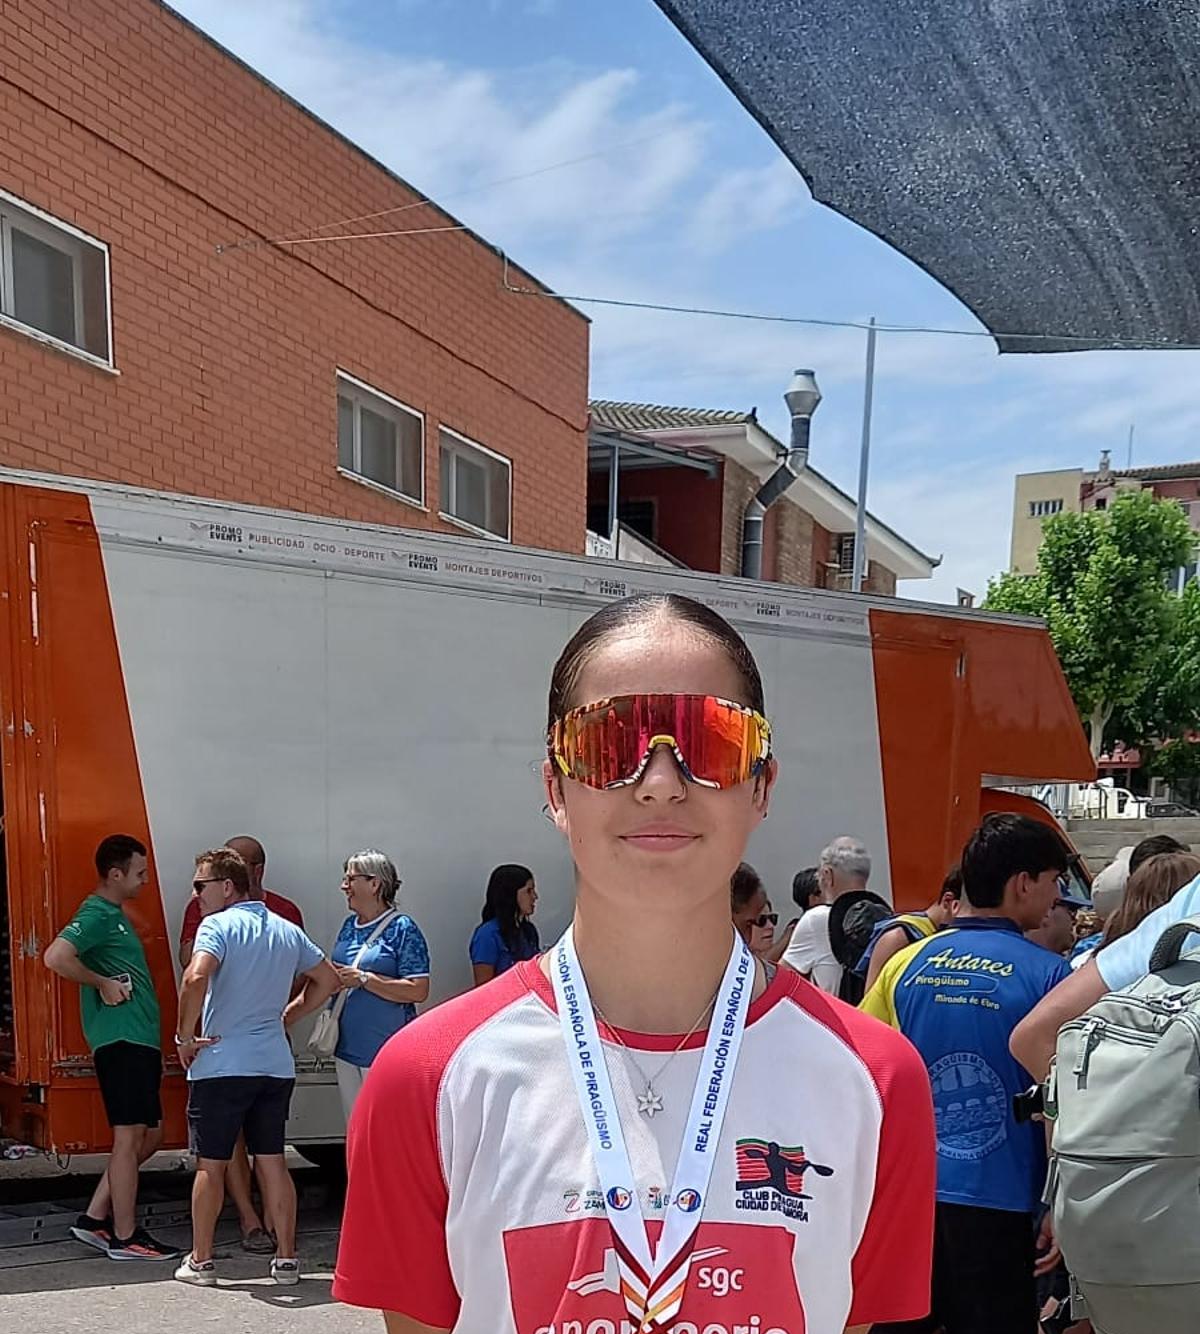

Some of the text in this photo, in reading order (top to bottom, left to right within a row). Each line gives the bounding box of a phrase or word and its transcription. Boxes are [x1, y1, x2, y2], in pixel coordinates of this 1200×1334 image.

[209, 524, 242, 535] PROMO
[209, 532, 242, 543] EVENTS
[249, 533, 304, 549] PUBLICIDAD
[313, 542, 336, 553] OCIO
[344, 548, 385, 561] DEPORTE
[408, 554, 438, 564] PROMO
[408, 561, 438, 571] EVENTS
[445, 562, 542, 583] MONTAJES DEPORTIVOS
[927, 948, 1013, 977] Antares
[935, 994, 1000, 1010] Miranda de Ebro
[563, 984, 587, 1049] ESPAÑOLA
[579, 1051, 593, 1068] DE
[695, 956, 749, 1152] REAL FEDERACIÓN ESPAÑOLA DE
[584, 1070, 612, 1150] PIRAGÜISMO
[743, 1191, 769, 1201] CLUB
[735, 1199, 769, 1211] CIUDAD
[698, 1267, 744, 1296] sgc
